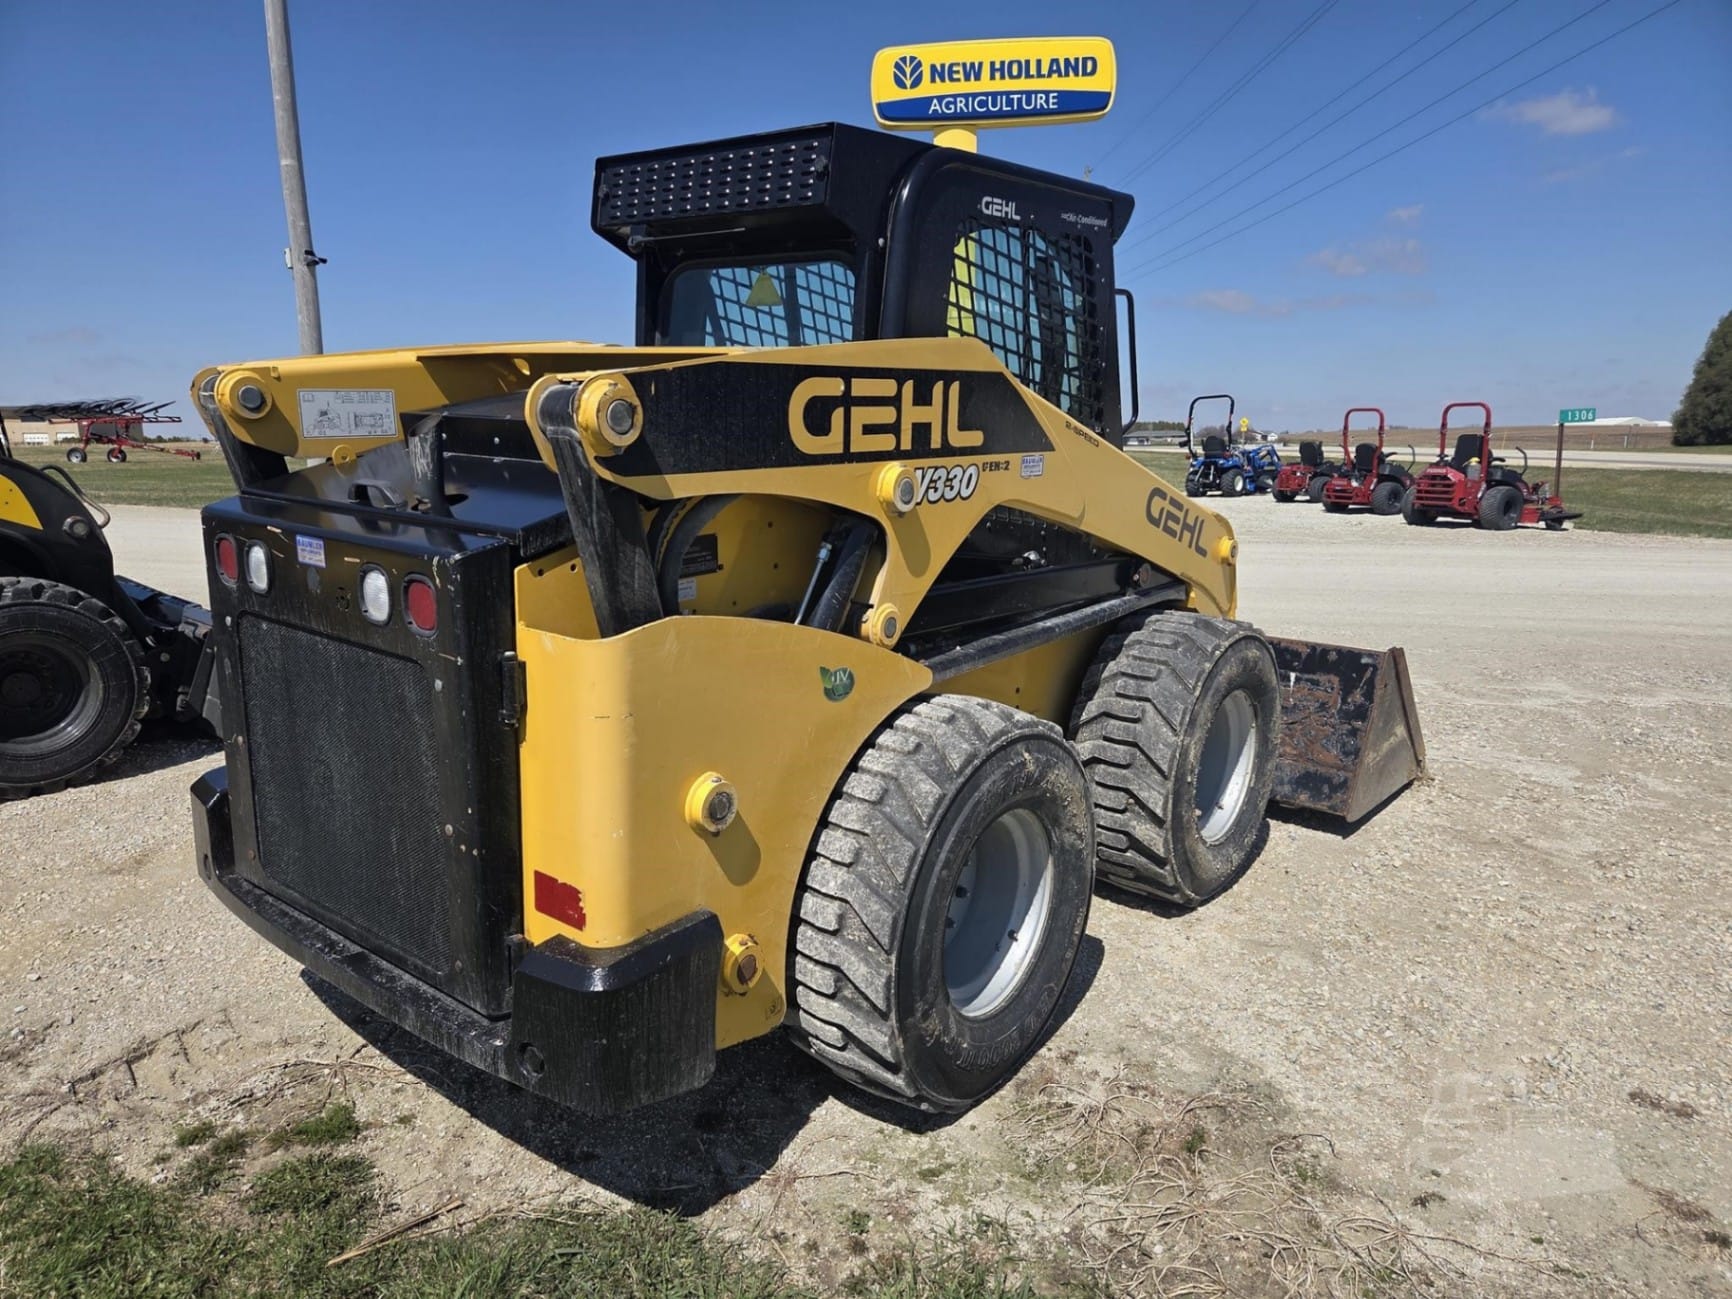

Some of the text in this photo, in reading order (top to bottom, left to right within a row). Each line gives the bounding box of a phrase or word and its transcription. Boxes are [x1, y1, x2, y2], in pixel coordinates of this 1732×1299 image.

[930, 56, 1098, 84] NEW HOLLAND
[928, 92, 1058, 115] AGRICULTURE
[981, 196, 1021, 221] GEHL
[788, 376, 984, 455] GEHL
[1568, 410, 1593, 421] 1306
[914, 463, 980, 506] V330
[1145, 486, 1208, 559] GEHL
